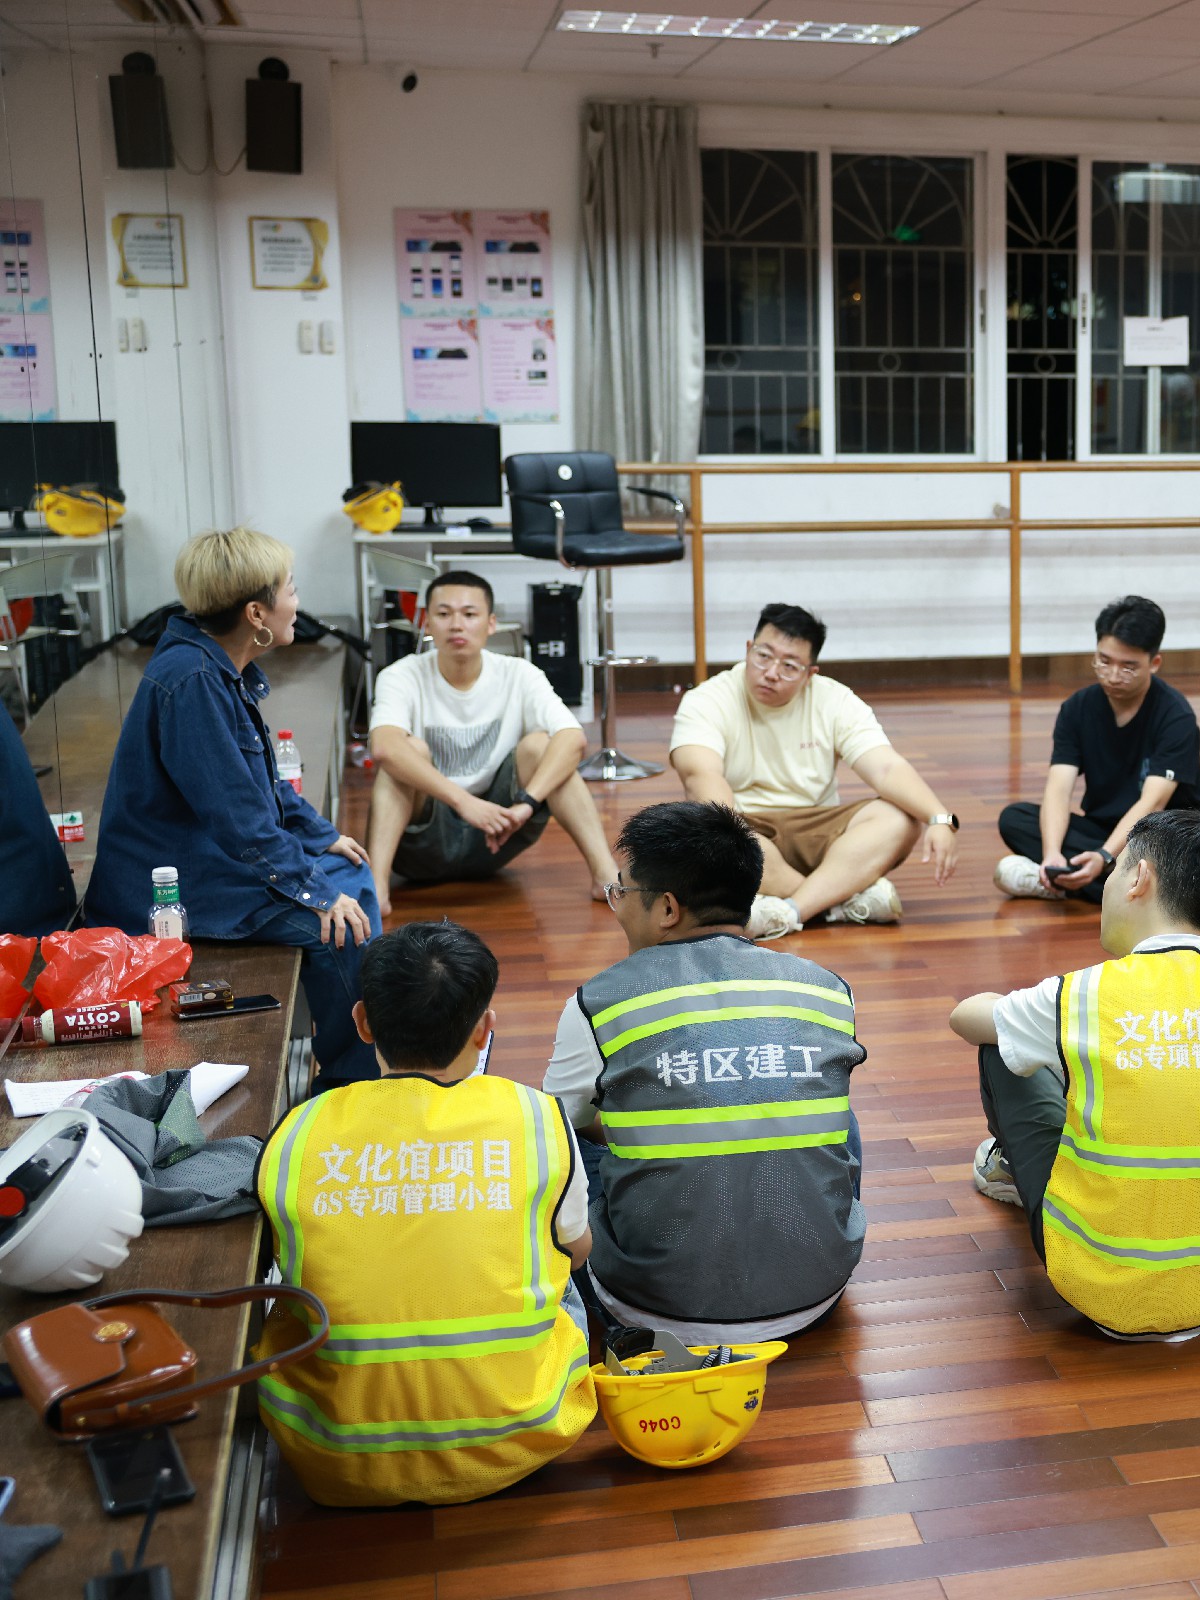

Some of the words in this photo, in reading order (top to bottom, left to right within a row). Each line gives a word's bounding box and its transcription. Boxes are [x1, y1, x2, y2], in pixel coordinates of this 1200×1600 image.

[64, 1010, 120, 1027] COSTA
[656, 1043, 823, 1087] 特区建工
[315, 1138, 511, 1186] 文化馆项目
[312, 1180, 514, 1218] 6S专项管理小组
